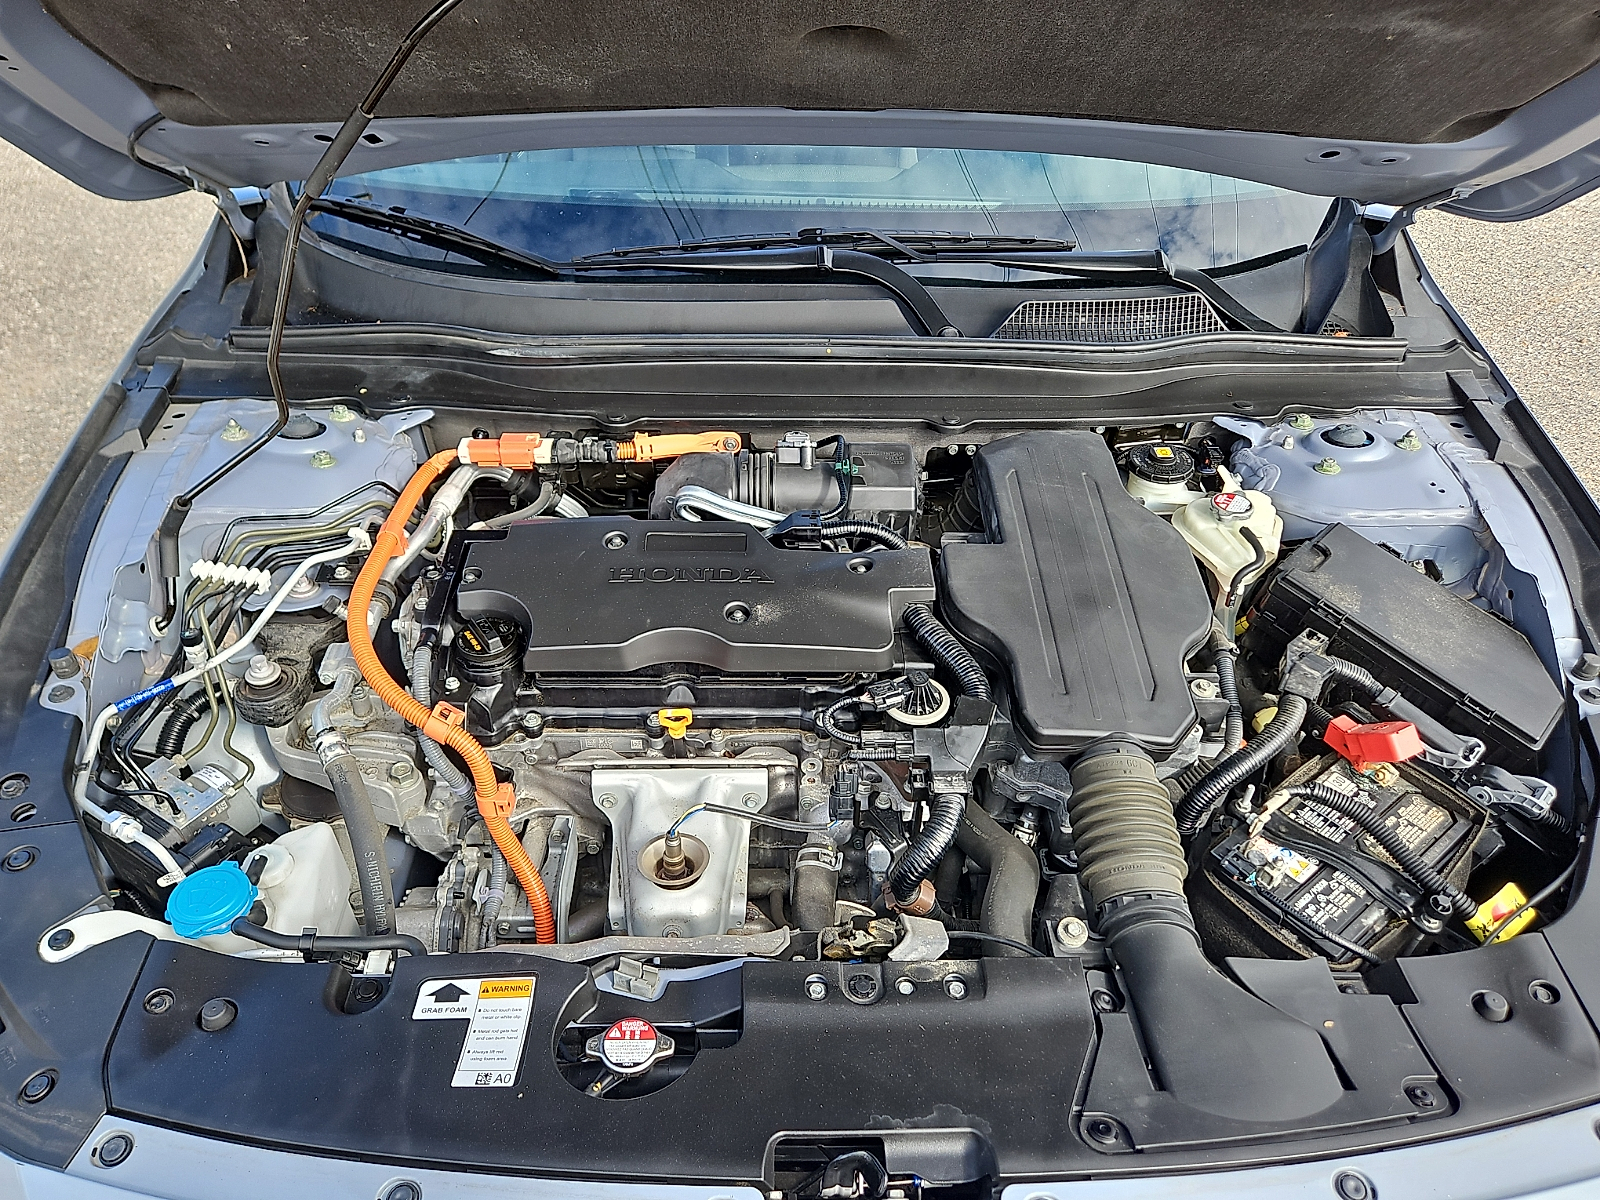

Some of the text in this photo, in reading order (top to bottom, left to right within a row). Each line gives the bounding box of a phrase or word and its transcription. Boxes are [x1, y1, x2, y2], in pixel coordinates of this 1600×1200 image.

[608, 567, 775, 583] HONDA
[491, 984, 530, 993] WARNING
[493, 1073, 512, 1084] A0
